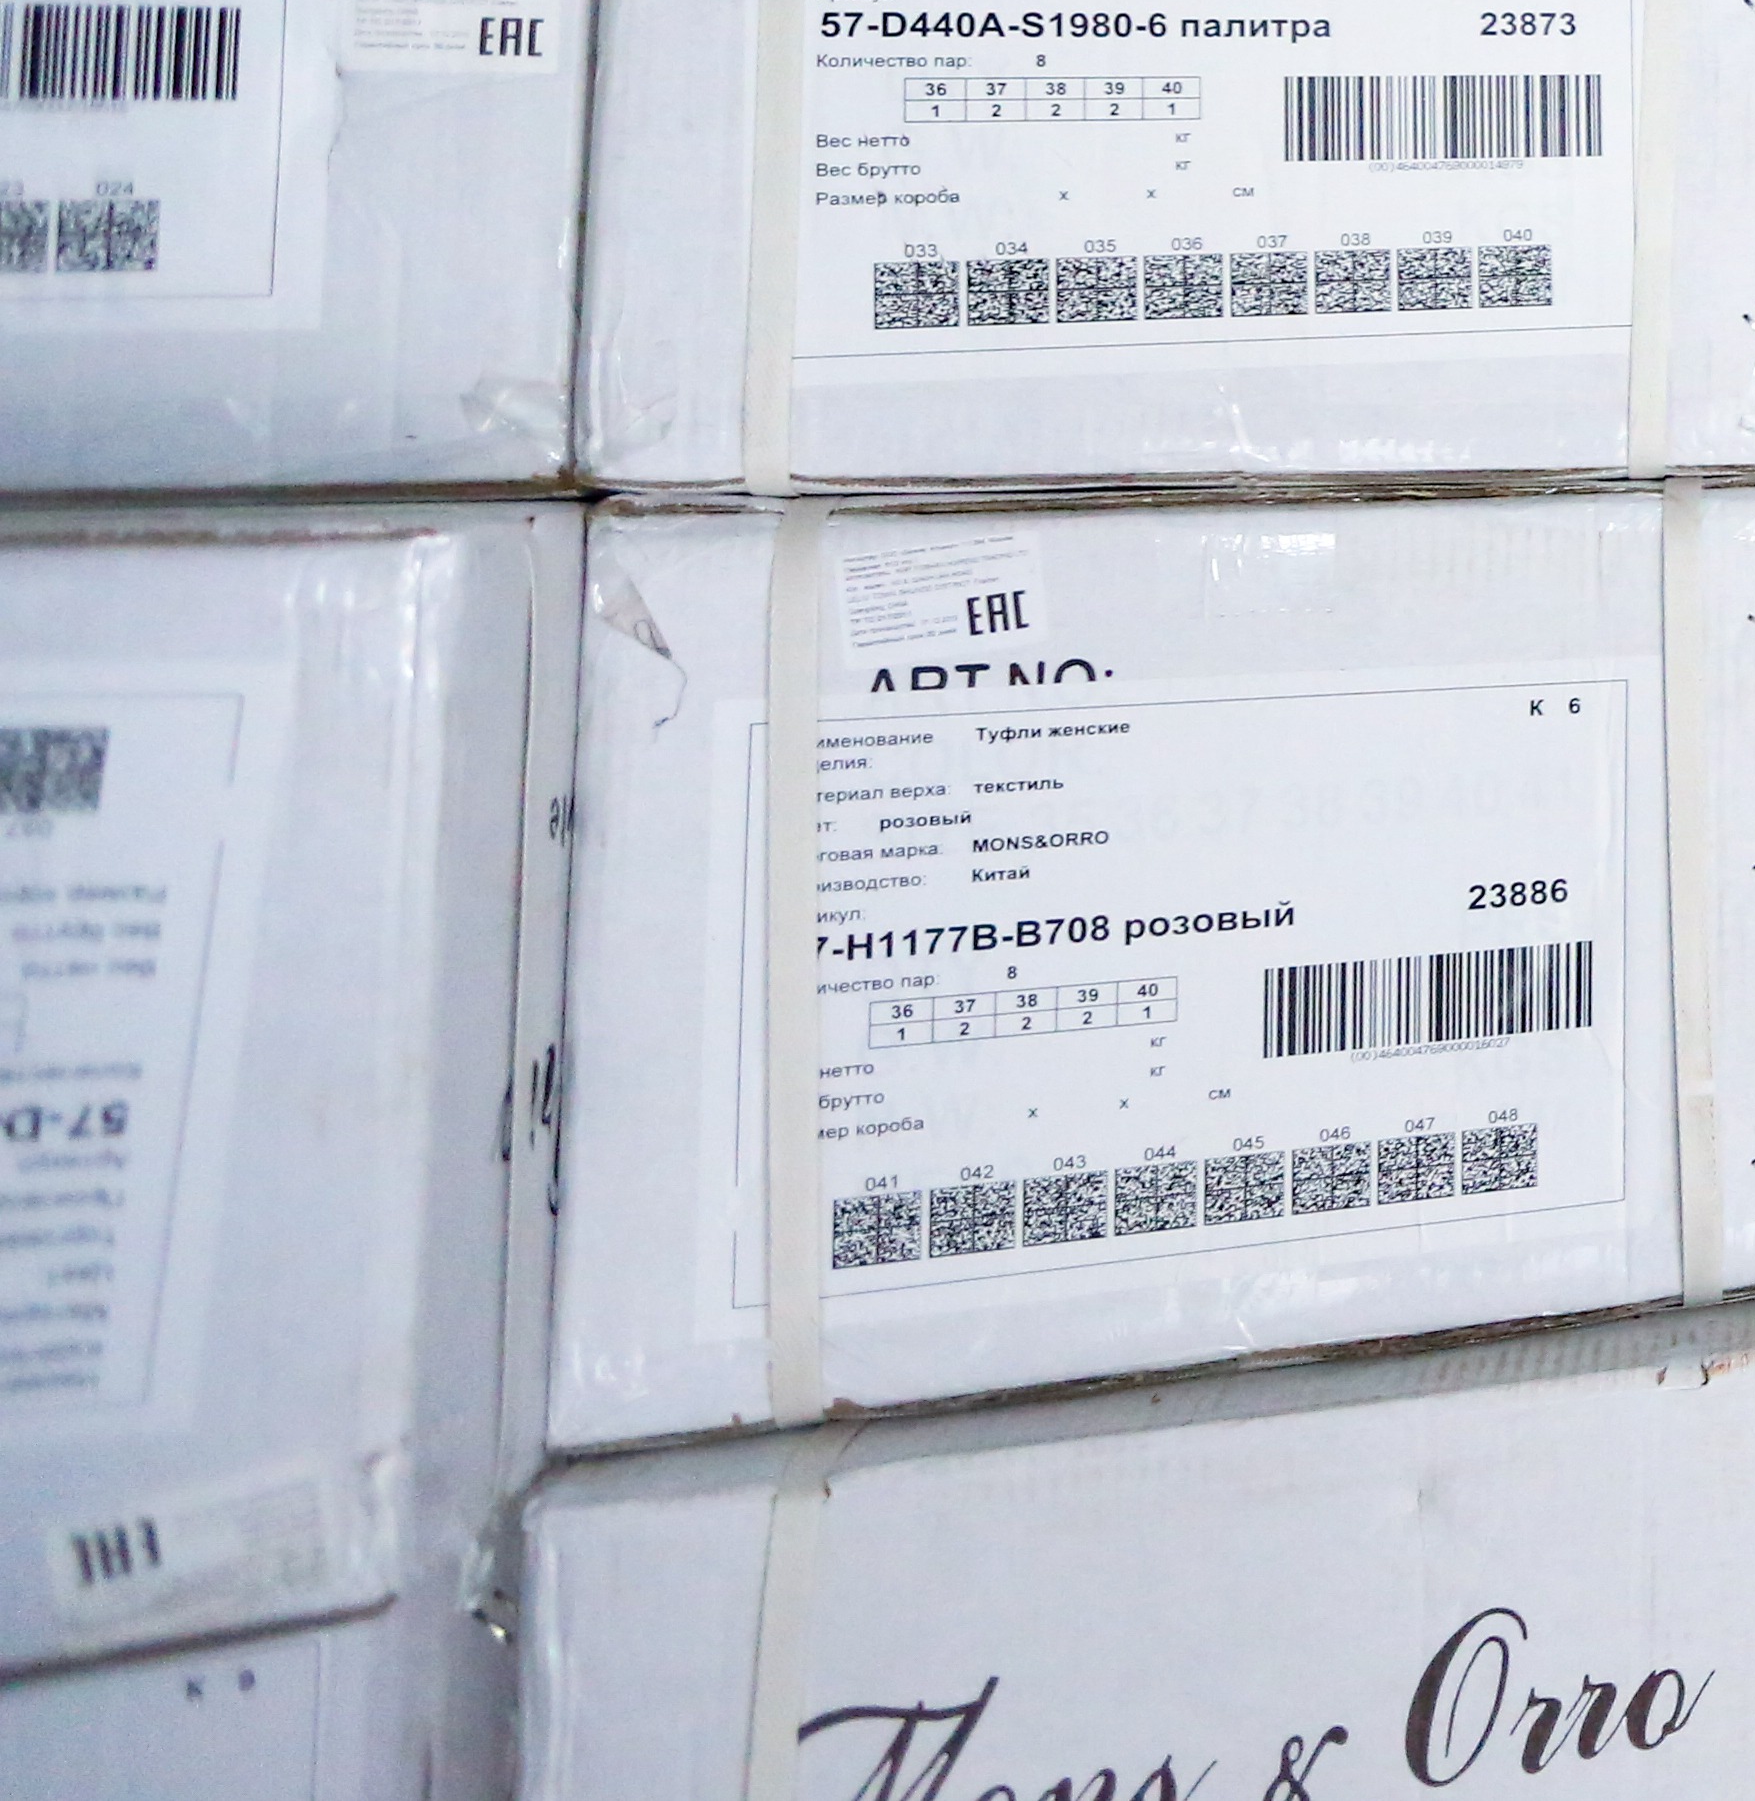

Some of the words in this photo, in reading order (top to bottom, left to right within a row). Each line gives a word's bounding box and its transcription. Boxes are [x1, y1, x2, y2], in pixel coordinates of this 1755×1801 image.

[820, 11, 1167, 38] 57-D440A-S1980-6
[1180, 18, 1331, 44] палитра
[1479, 11, 1577, 37] 23873
[816, 53, 928, 68] Количество
[933, 56, 972, 71] пар:
[1035, 53, 1047, 68] 8
[815, 133, 852, 149] Вес
[857, 134, 911, 148] нетто
[815, 162, 852, 178] Вес
[856, 161, 922, 180] брутто
[815, 190, 888, 208] Размер
[893, 185, 961, 208] короба
[1502, 228, 1534, 243] 040
[1568, 697, 1581, 715] 6
[975, 726, 1042, 745] Туфли
[1047, 722, 1131, 738] женские
[973, 778, 1065, 794] текстиль
[879, 810, 972, 834] розовый
[972, 830, 1110, 853] MONS&ORRO
[971, 865, 1031, 883] Китай
[1467, 878, 1569, 911] 23886
[816, 911, 1110, 962] 7-H1177B-B708
[1124, 900, 1295, 947] розовый
[1006, 965, 1018, 980] 8
[818, 1063, 875, 1080] нетто
[855, 1116, 925, 1138] короба
[1404, 1116, 1436, 1134] 047
[1487, 1107, 1519, 1125] 048
[1405, 1606, 1716, 1788] Orro
